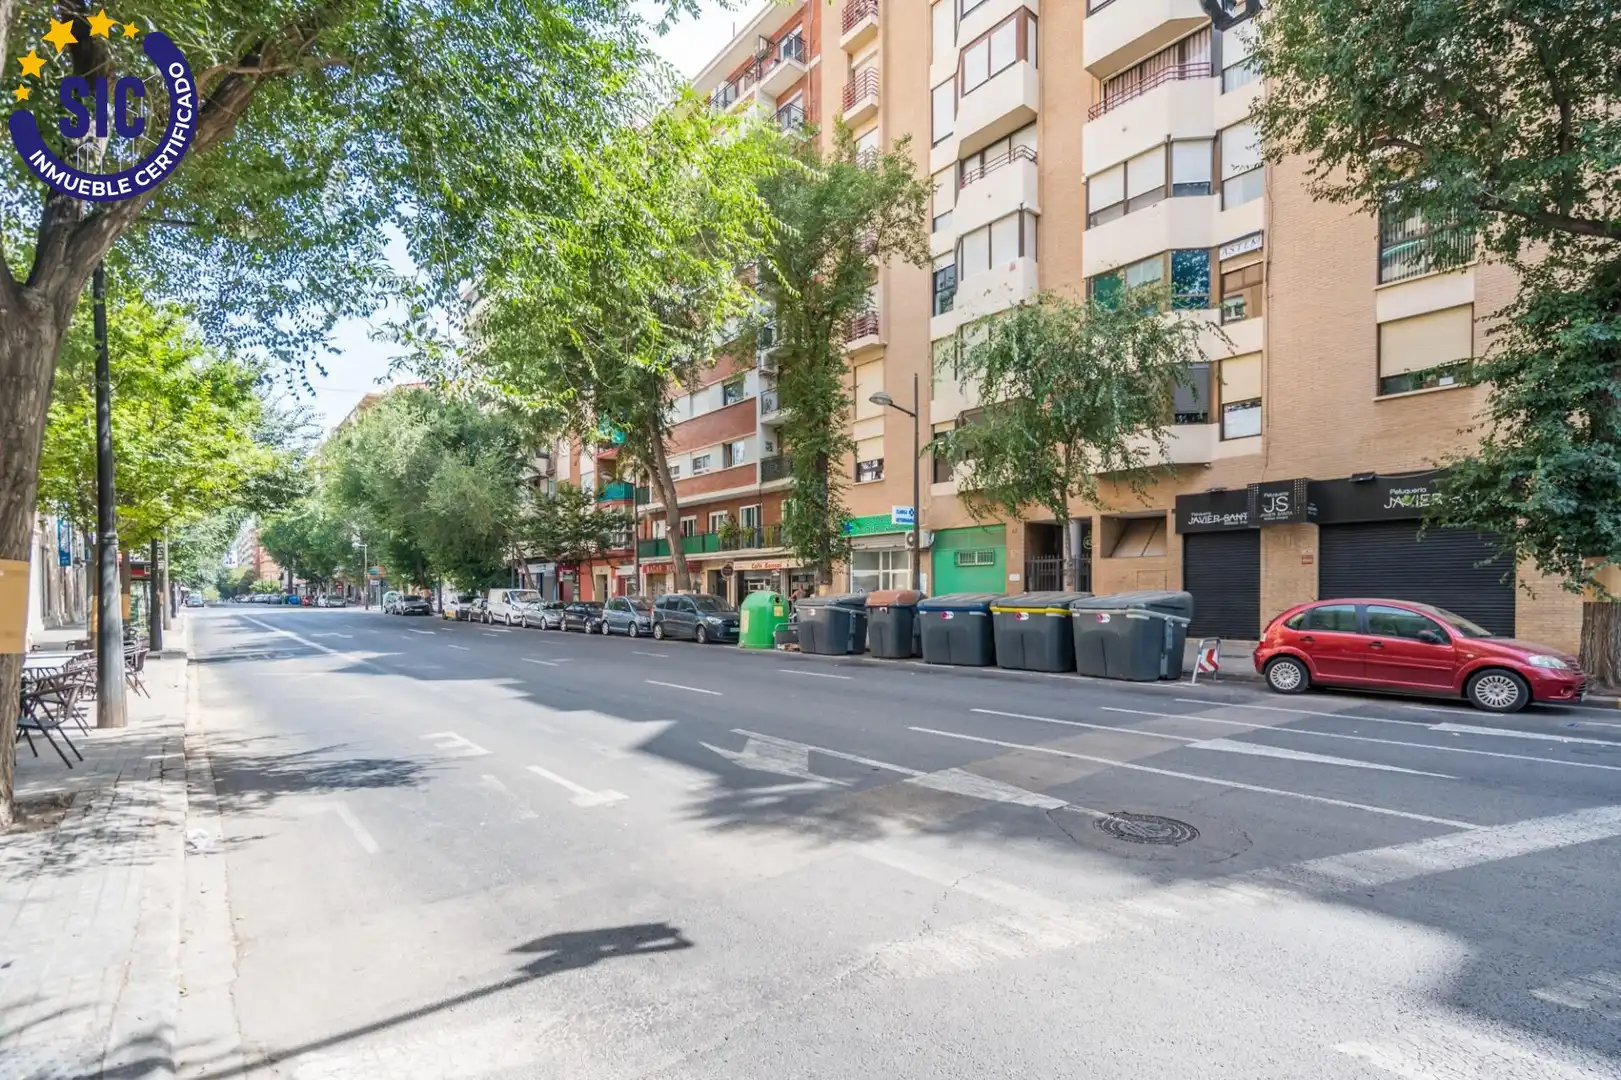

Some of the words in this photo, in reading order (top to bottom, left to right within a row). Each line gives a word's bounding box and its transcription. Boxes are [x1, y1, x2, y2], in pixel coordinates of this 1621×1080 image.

[1263, 496, 1288, 513] JS
[1384, 493, 1443, 509] JAVIER
[1188, 514, 1220, 524] JAVIER
